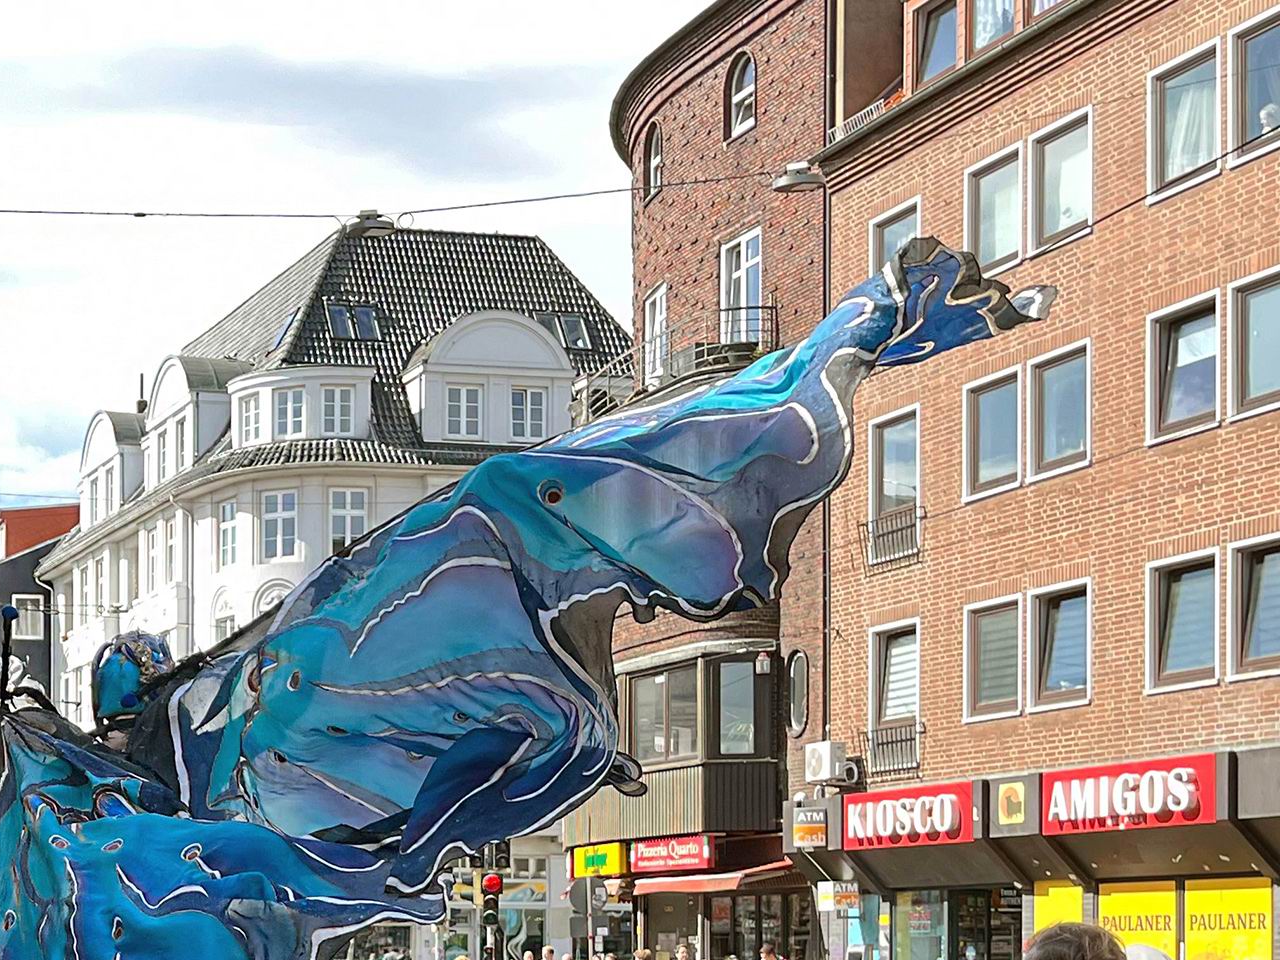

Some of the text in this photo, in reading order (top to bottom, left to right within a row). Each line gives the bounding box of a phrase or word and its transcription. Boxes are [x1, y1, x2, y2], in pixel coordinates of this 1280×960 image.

[1048, 767, 1194, 821] AMIGOS
[797, 811, 824, 822] ATM
[847, 793, 956, 839] KIOSCO
[795, 830, 826, 844] Cash
[637, 841, 699, 858] Pizzeria Quarto
[834, 883, 858, 892] ATM
[1102, 914, 1171, 931] PAULANER
[1189, 912, 1267, 931] PAULANER
